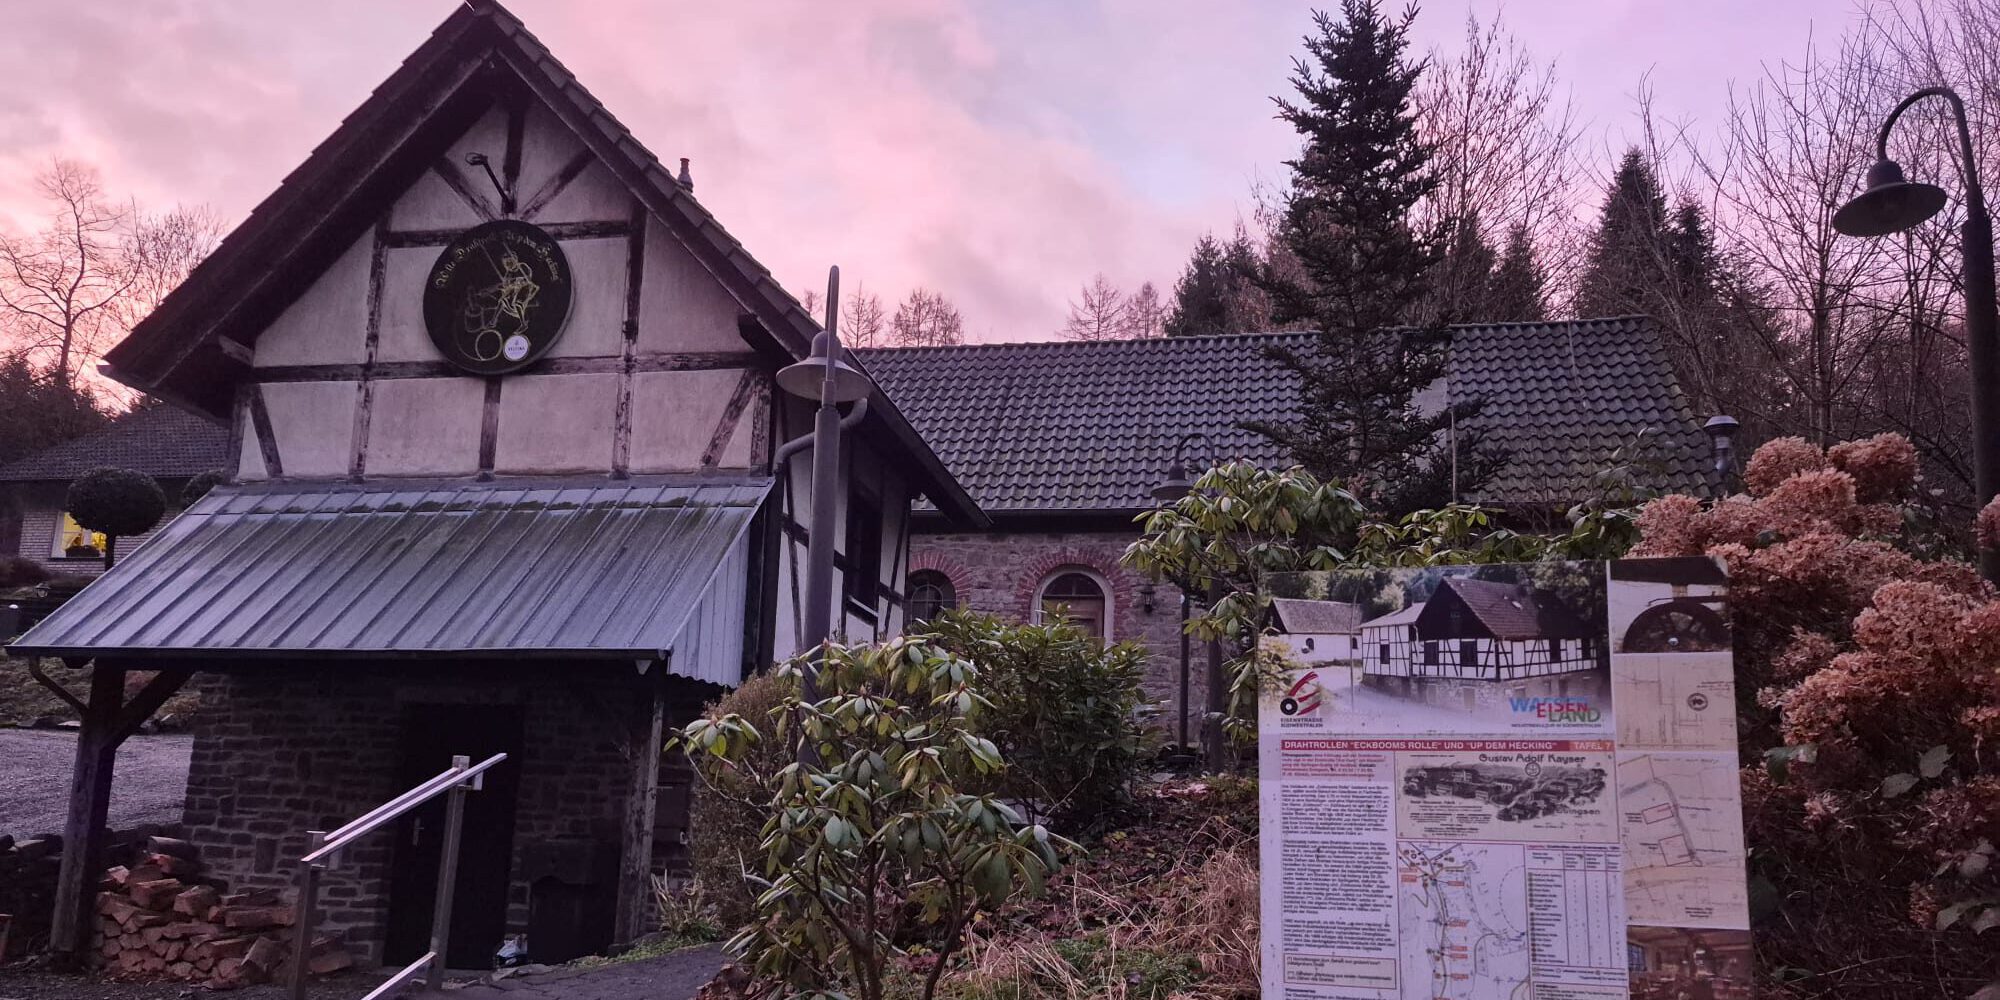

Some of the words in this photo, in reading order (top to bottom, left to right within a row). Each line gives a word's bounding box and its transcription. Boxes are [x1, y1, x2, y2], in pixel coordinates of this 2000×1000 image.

[1536, 703, 1588, 718] EISEN
[1549, 708, 1601, 722] LAND
[1284, 741, 1348, 749] DRAHTROLLEN
[1351, 741, 1405, 749] "ECKBOOMS
[1408, 741, 1441, 749] ROLLE"
[1509, 742, 1557, 750] HECKING"
[1479, 754, 1513, 763] Gustav
[1515, 754, 1543, 763] Adolf
[1548, 754, 1587, 764] Kayser
